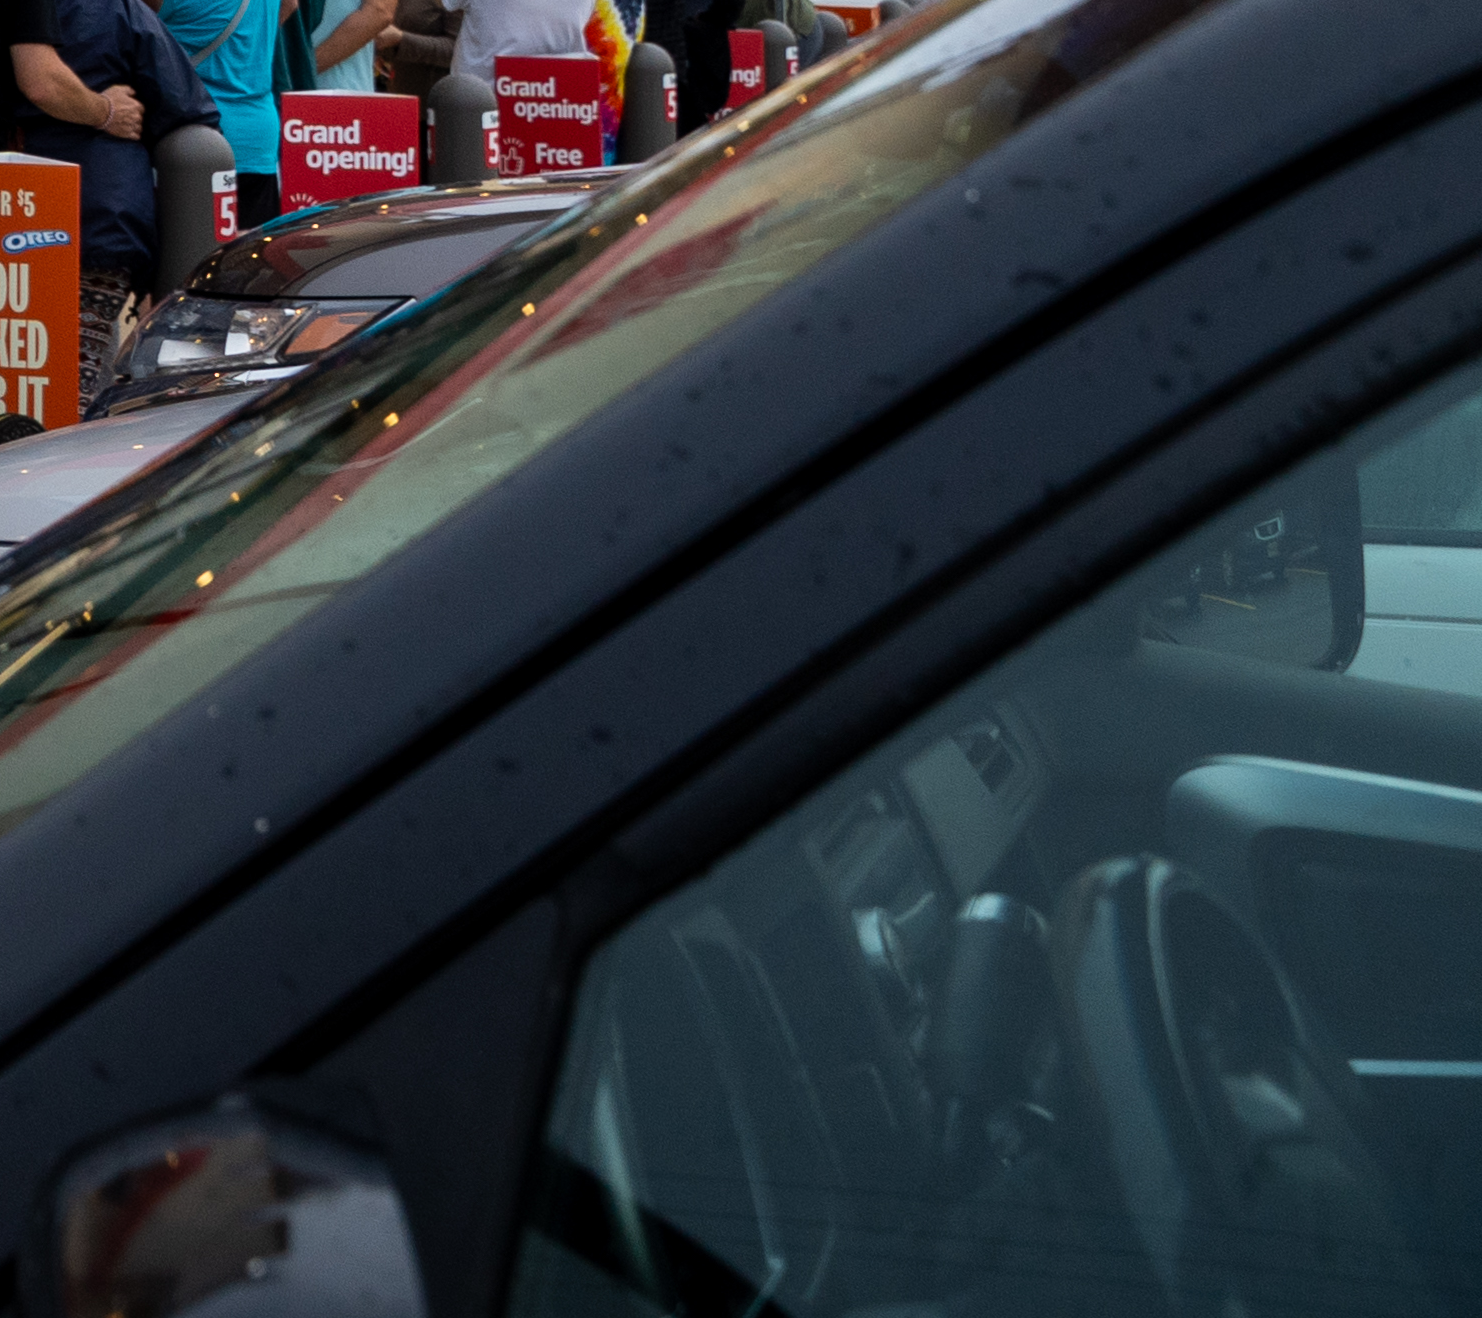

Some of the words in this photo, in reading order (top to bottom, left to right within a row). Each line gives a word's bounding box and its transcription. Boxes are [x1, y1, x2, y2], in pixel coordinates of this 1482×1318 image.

[497, 76, 556, 98] Grand
[514, 98, 598, 125] opening!
[283, 119, 360, 144] Grand
[306, 146, 415, 177] opening!
[535, 143, 583, 166] Free
[17, 188, 35, 217] $5
[220, 196, 238, 237] 5
[3, 230, 70, 252] OREO
[18, 375, 50, 425] IT
